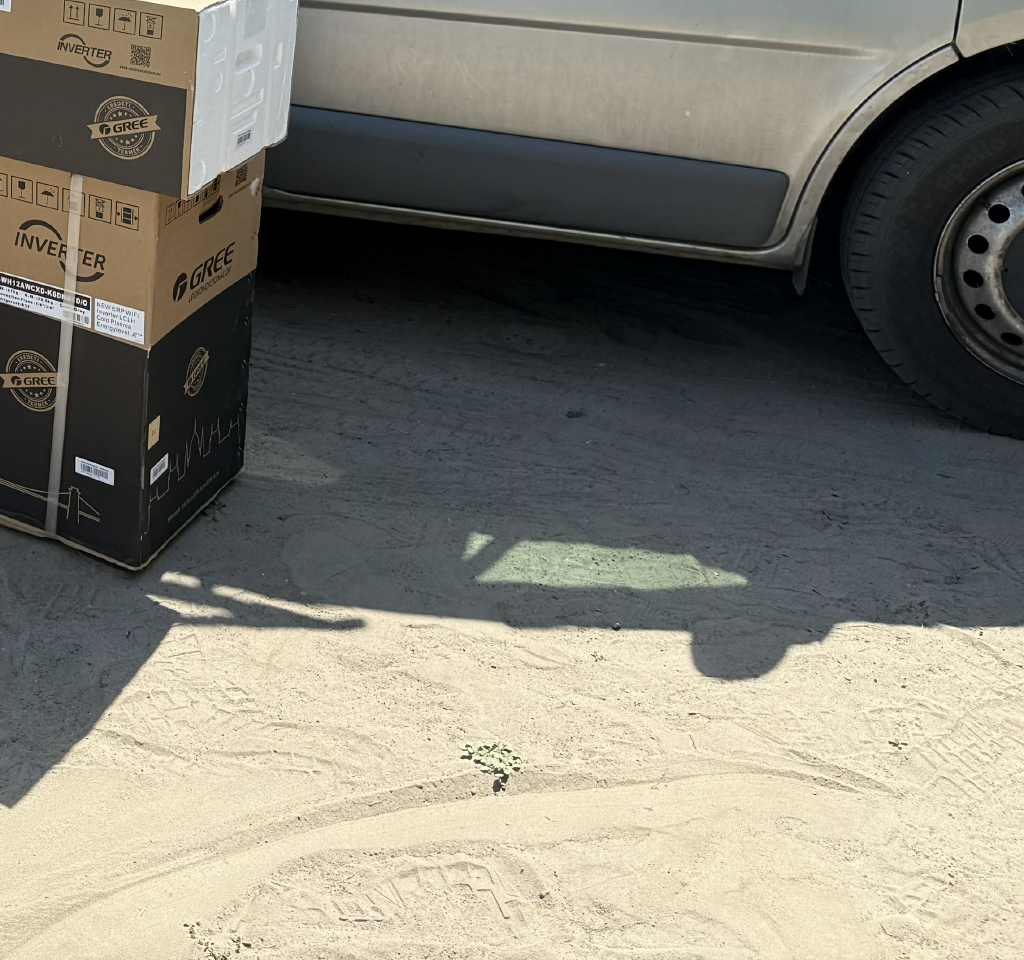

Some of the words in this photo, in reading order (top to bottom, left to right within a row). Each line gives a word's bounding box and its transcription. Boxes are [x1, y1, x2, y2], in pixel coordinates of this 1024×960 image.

[57, 41, 113, 61] INVERTER
[113, 118, 149, 133] GREE
[189, 241, 236, 291] GREE
[23, 376, 57, 386] GREE
